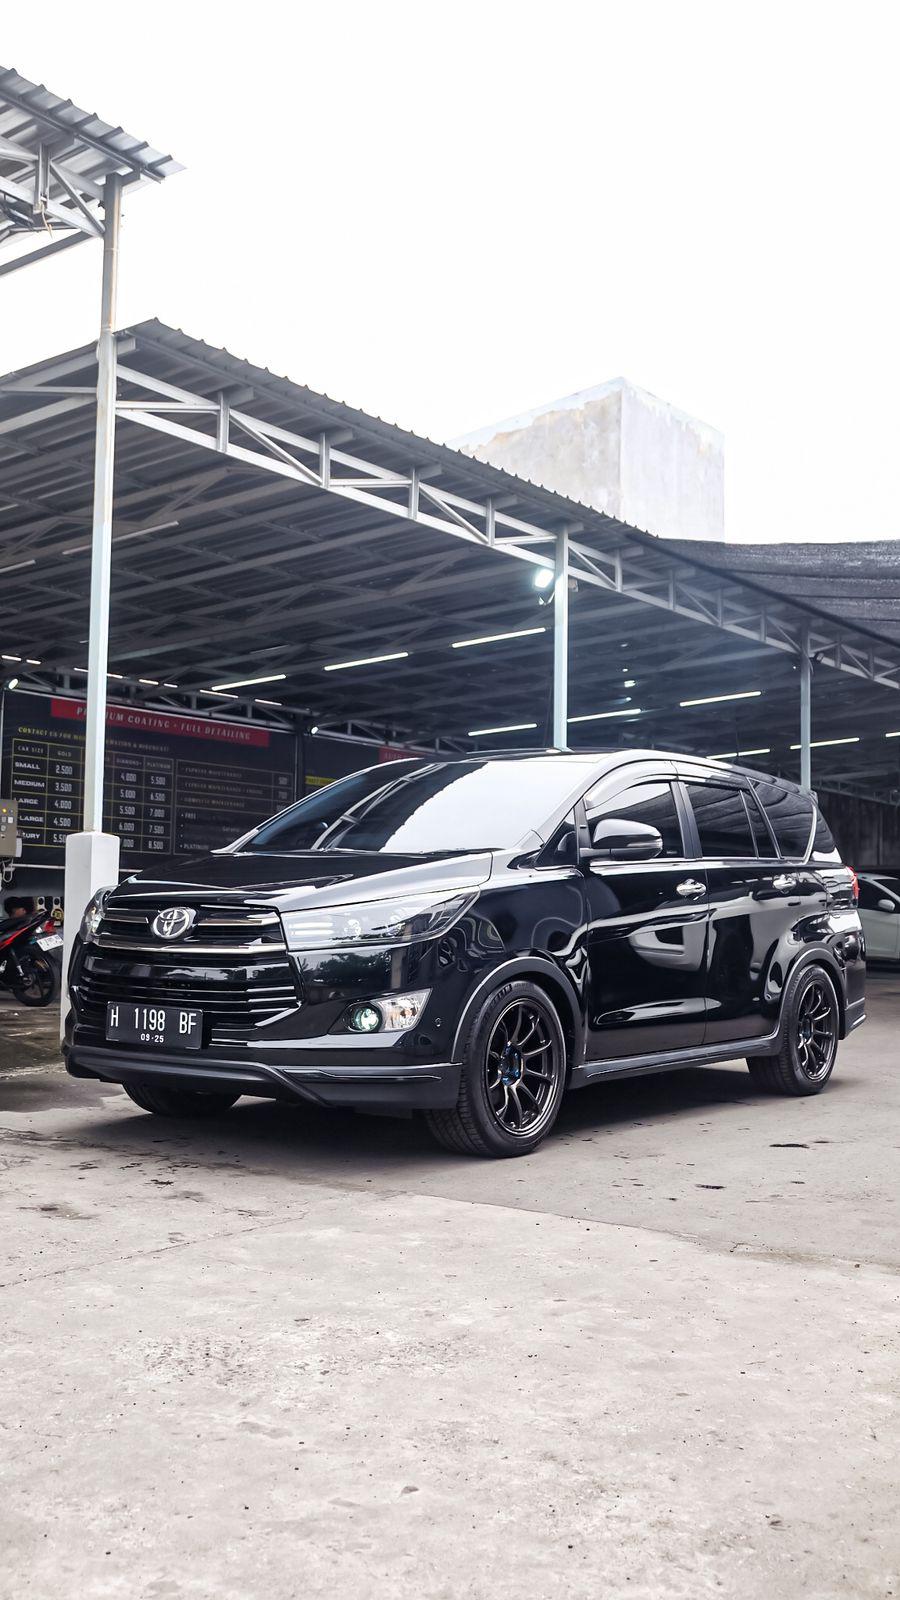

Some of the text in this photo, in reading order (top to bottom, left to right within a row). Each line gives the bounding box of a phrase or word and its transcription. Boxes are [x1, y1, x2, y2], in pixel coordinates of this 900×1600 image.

[18, 727, 48, 736] CONTACT
[128, 715, 170, 729] COATING
[181, 722, 201, 734] FULL
[205, 726, 251, 740] DETAILING
[15, 762, 40, 770] SMALL
[56, 765, 73, 775] 2.500
[14, 779, 45, 788] MEDIUM
[55, 782, 72, 792] 3.500
[54, 799, 72, 810] 4.000
[53, 817, 71, 827] 4.500
[110, 1006, 197, 1035] H 1198 BF
